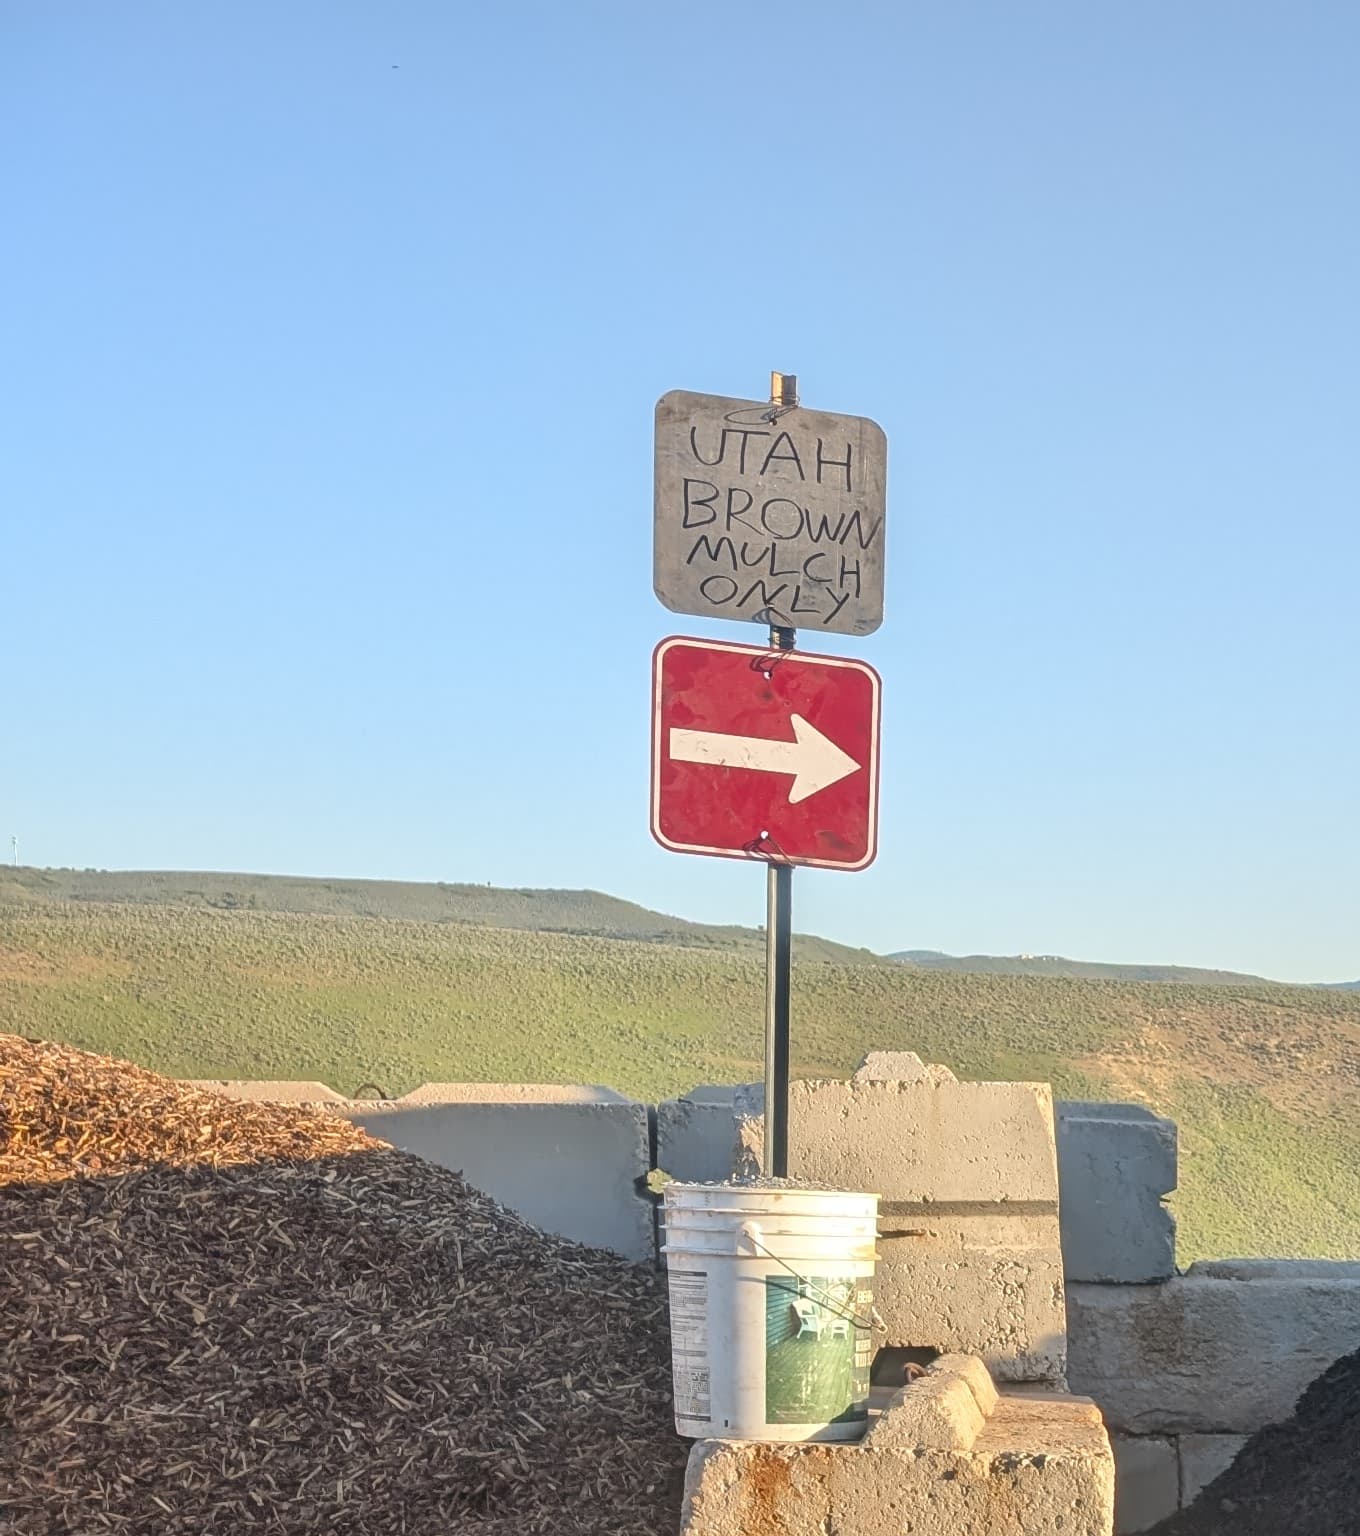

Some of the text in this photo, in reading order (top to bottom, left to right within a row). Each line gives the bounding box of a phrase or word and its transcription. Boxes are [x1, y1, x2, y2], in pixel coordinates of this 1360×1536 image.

[690, 426, 852, 492] UTAH
[682, 478, 882, 549] BROWN
[687, 534, 860, 598] MULCH
[700, 575, 849, 624] ONLY
